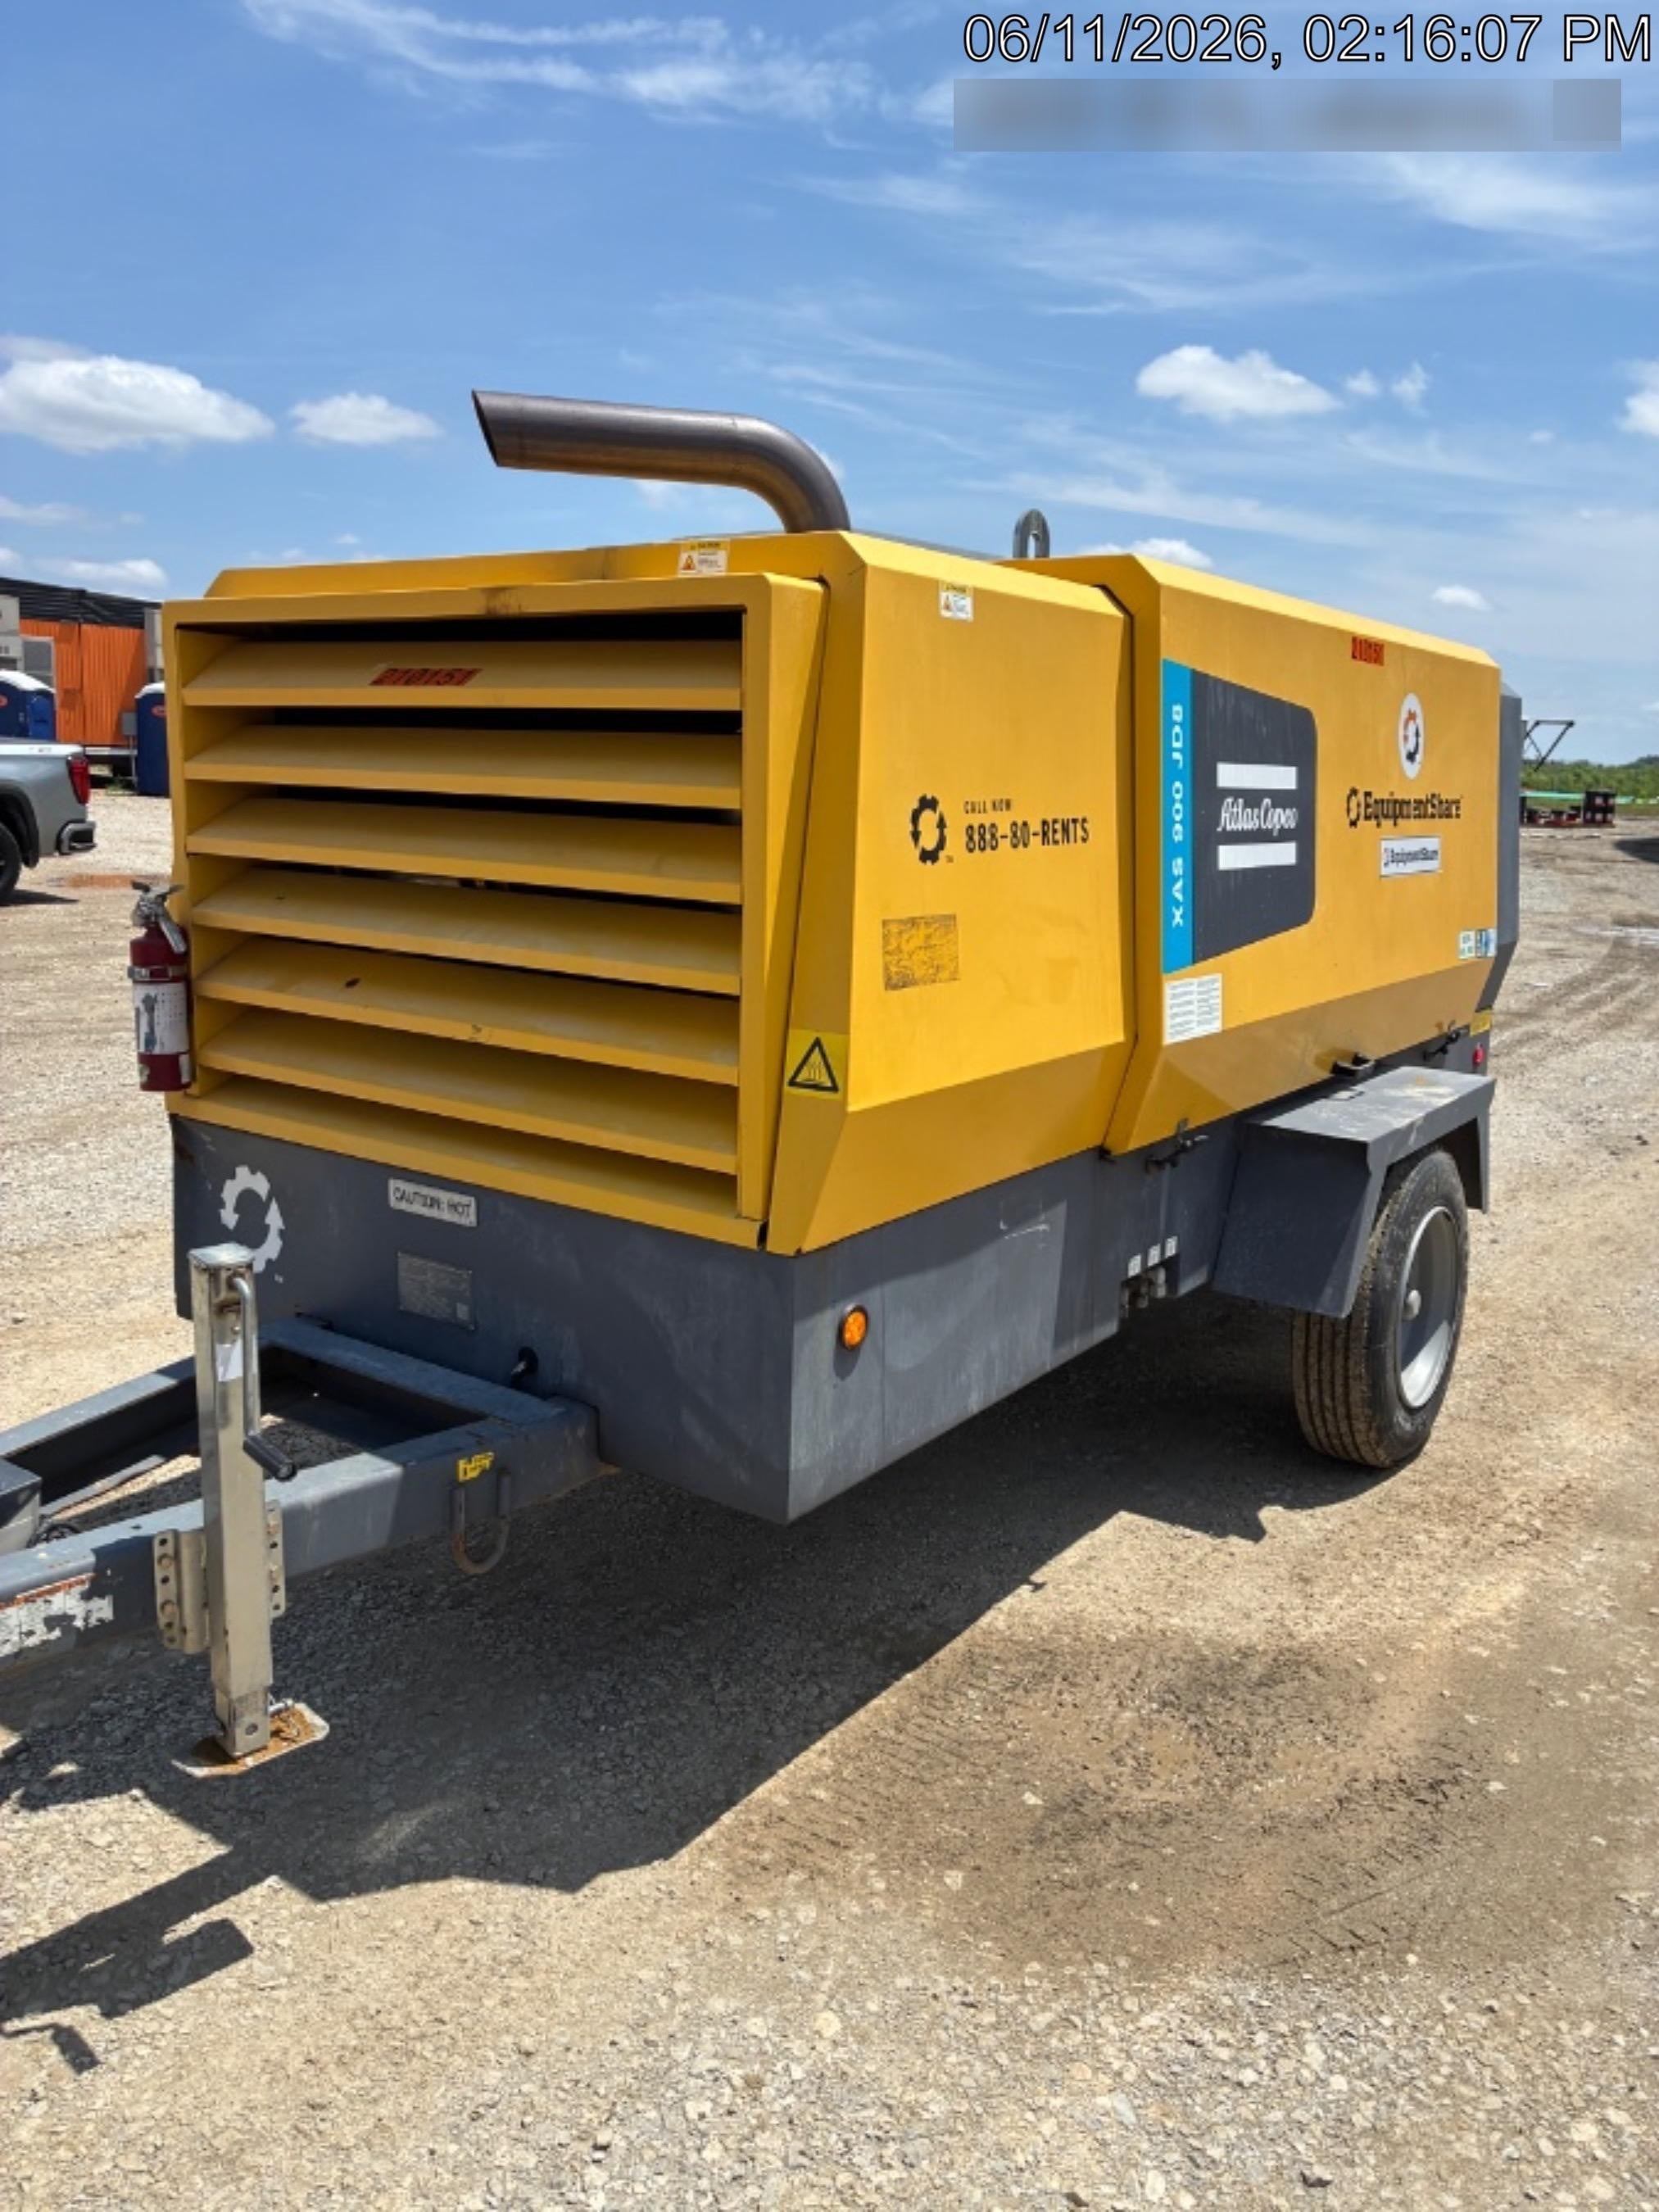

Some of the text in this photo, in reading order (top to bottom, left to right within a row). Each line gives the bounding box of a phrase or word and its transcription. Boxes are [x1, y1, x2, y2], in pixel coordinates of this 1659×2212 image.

[963, 798, 1012, 814] CALL NOW
[1172, 704, 1184, 927] XAS 900 JD8
[1217, 796, 1299, 836] Atlas Copco
[1363, 791, 1461, 828] EquipmentShare
[964, 816, 1090, 854] 888-80-RENTS
